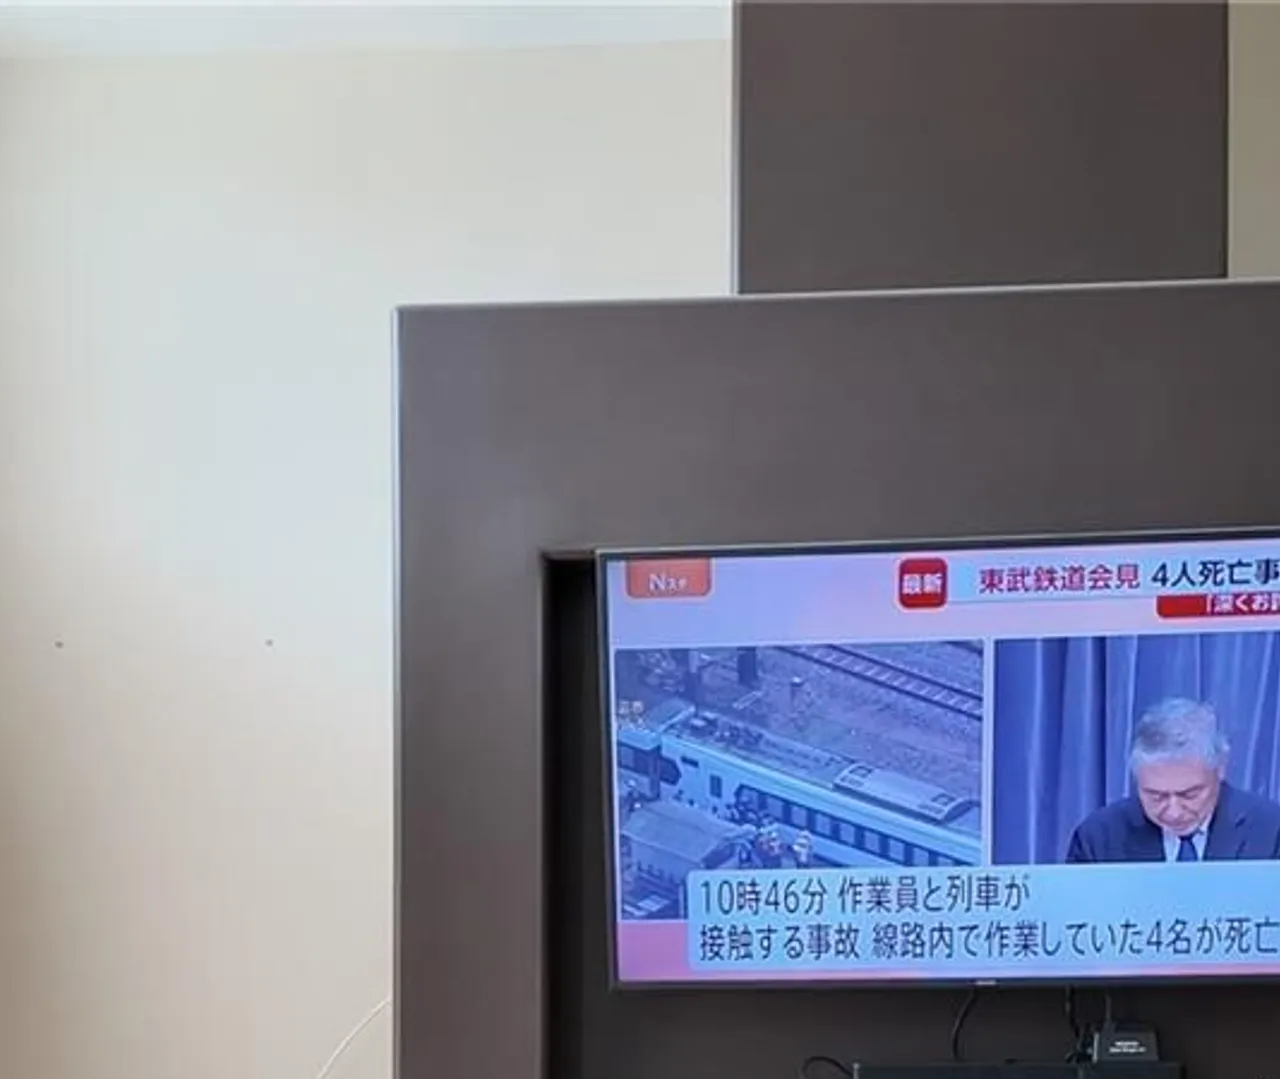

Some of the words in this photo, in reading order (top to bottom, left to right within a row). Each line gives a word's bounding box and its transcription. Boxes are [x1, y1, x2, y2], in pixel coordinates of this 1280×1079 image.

[902, 571, 943, 596] 最新
[979, 563, 1141, 593] 東武鉄道会見
[699, 876, 828, 916] 10時46分
[837, 873, 1031, 915] 作業員と列車が
[699, 923, 861, 961] 接触する事故
